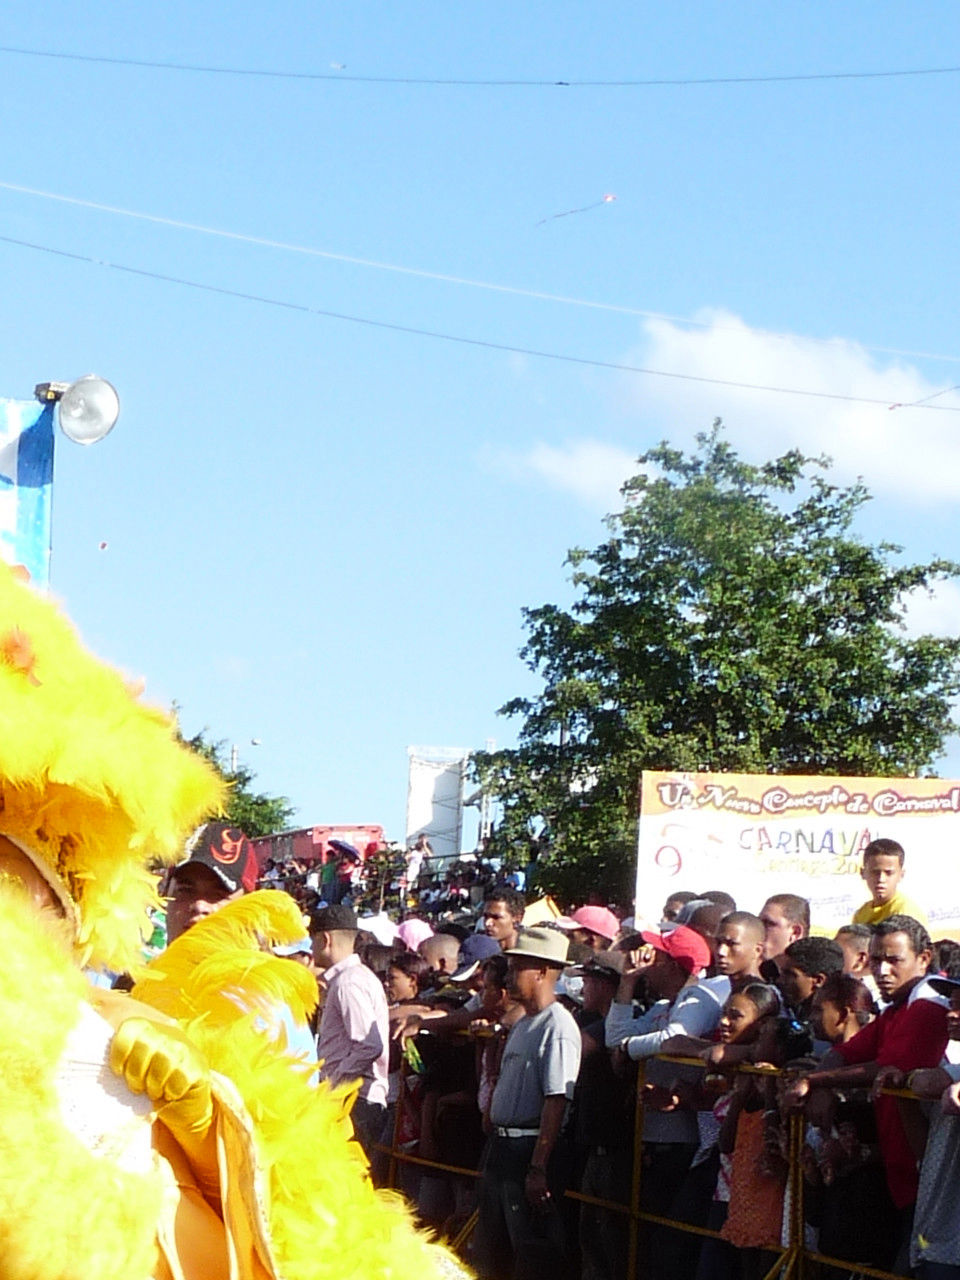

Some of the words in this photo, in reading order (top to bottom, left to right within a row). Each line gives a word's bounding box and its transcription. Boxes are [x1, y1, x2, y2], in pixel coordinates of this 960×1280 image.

[762, 786, 851, 814] Concepto
[845, 793, 871, 814] de
[871, 787, 960, 816] Carnaval
[739, 826, 880, 857] CARNAVA
